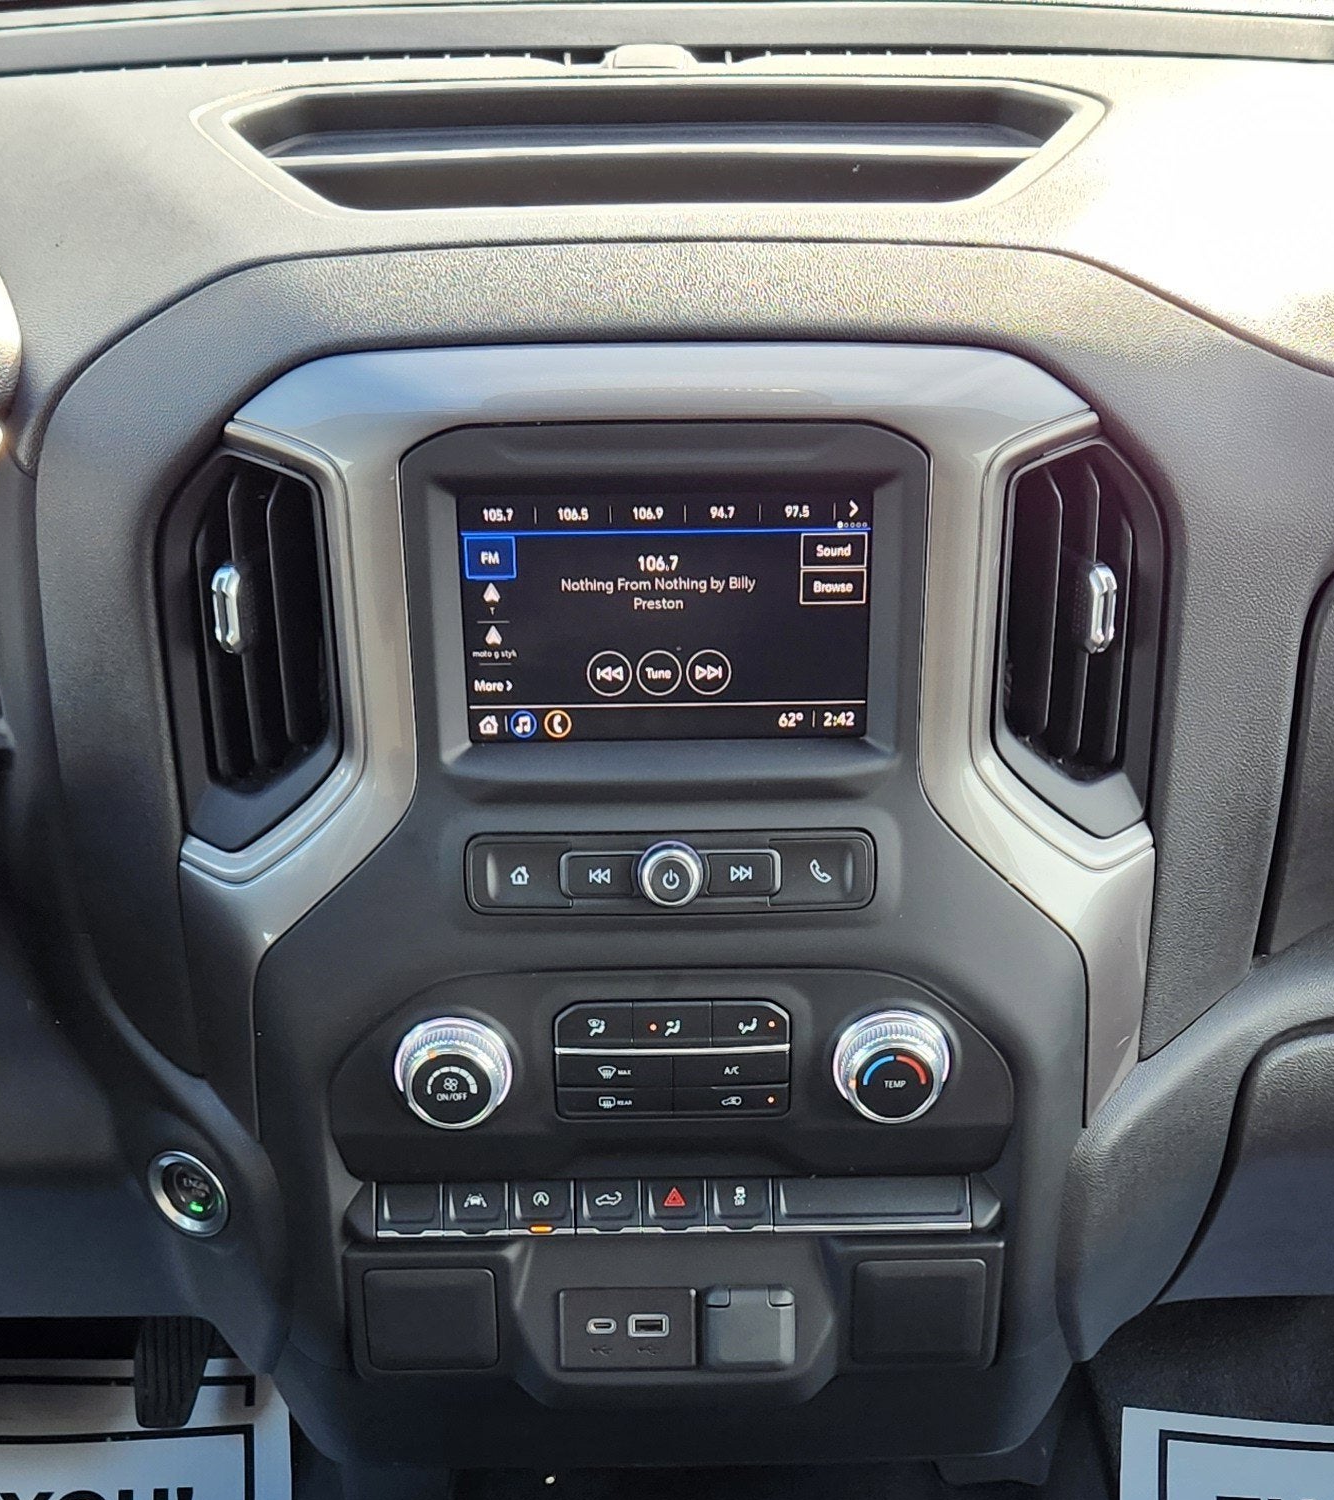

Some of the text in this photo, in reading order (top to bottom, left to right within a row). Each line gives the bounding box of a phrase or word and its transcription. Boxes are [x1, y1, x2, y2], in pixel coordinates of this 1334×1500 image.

[482, 508, 514, 522] 105.7
[632, 506, 664, 521] 106.9
[709, 505, 736, 519] 94.7
[784, 505, 810, 519] 97.5
[816, 543, 851, 557] Sound
[480, 551, 500, 565] FM
[637, 554, 679, 572] 106.7
[560, 575, 756, 594] Nothing From Nothing by Billy
[813, 581, 854, 593] Browse
[633, 597, 684, 610] Preston
[472, 650, 493, 658] moto
[645, 667, 672, 680] Tune
[474, 680, 505, 692] More
[823, 711, 855, 727] 2:42
[724, 1065, 740, 1075] A/C
[884, 1080, 907, 1089] TEMP
[436, 1092, 468, 1101] ON/OFF
